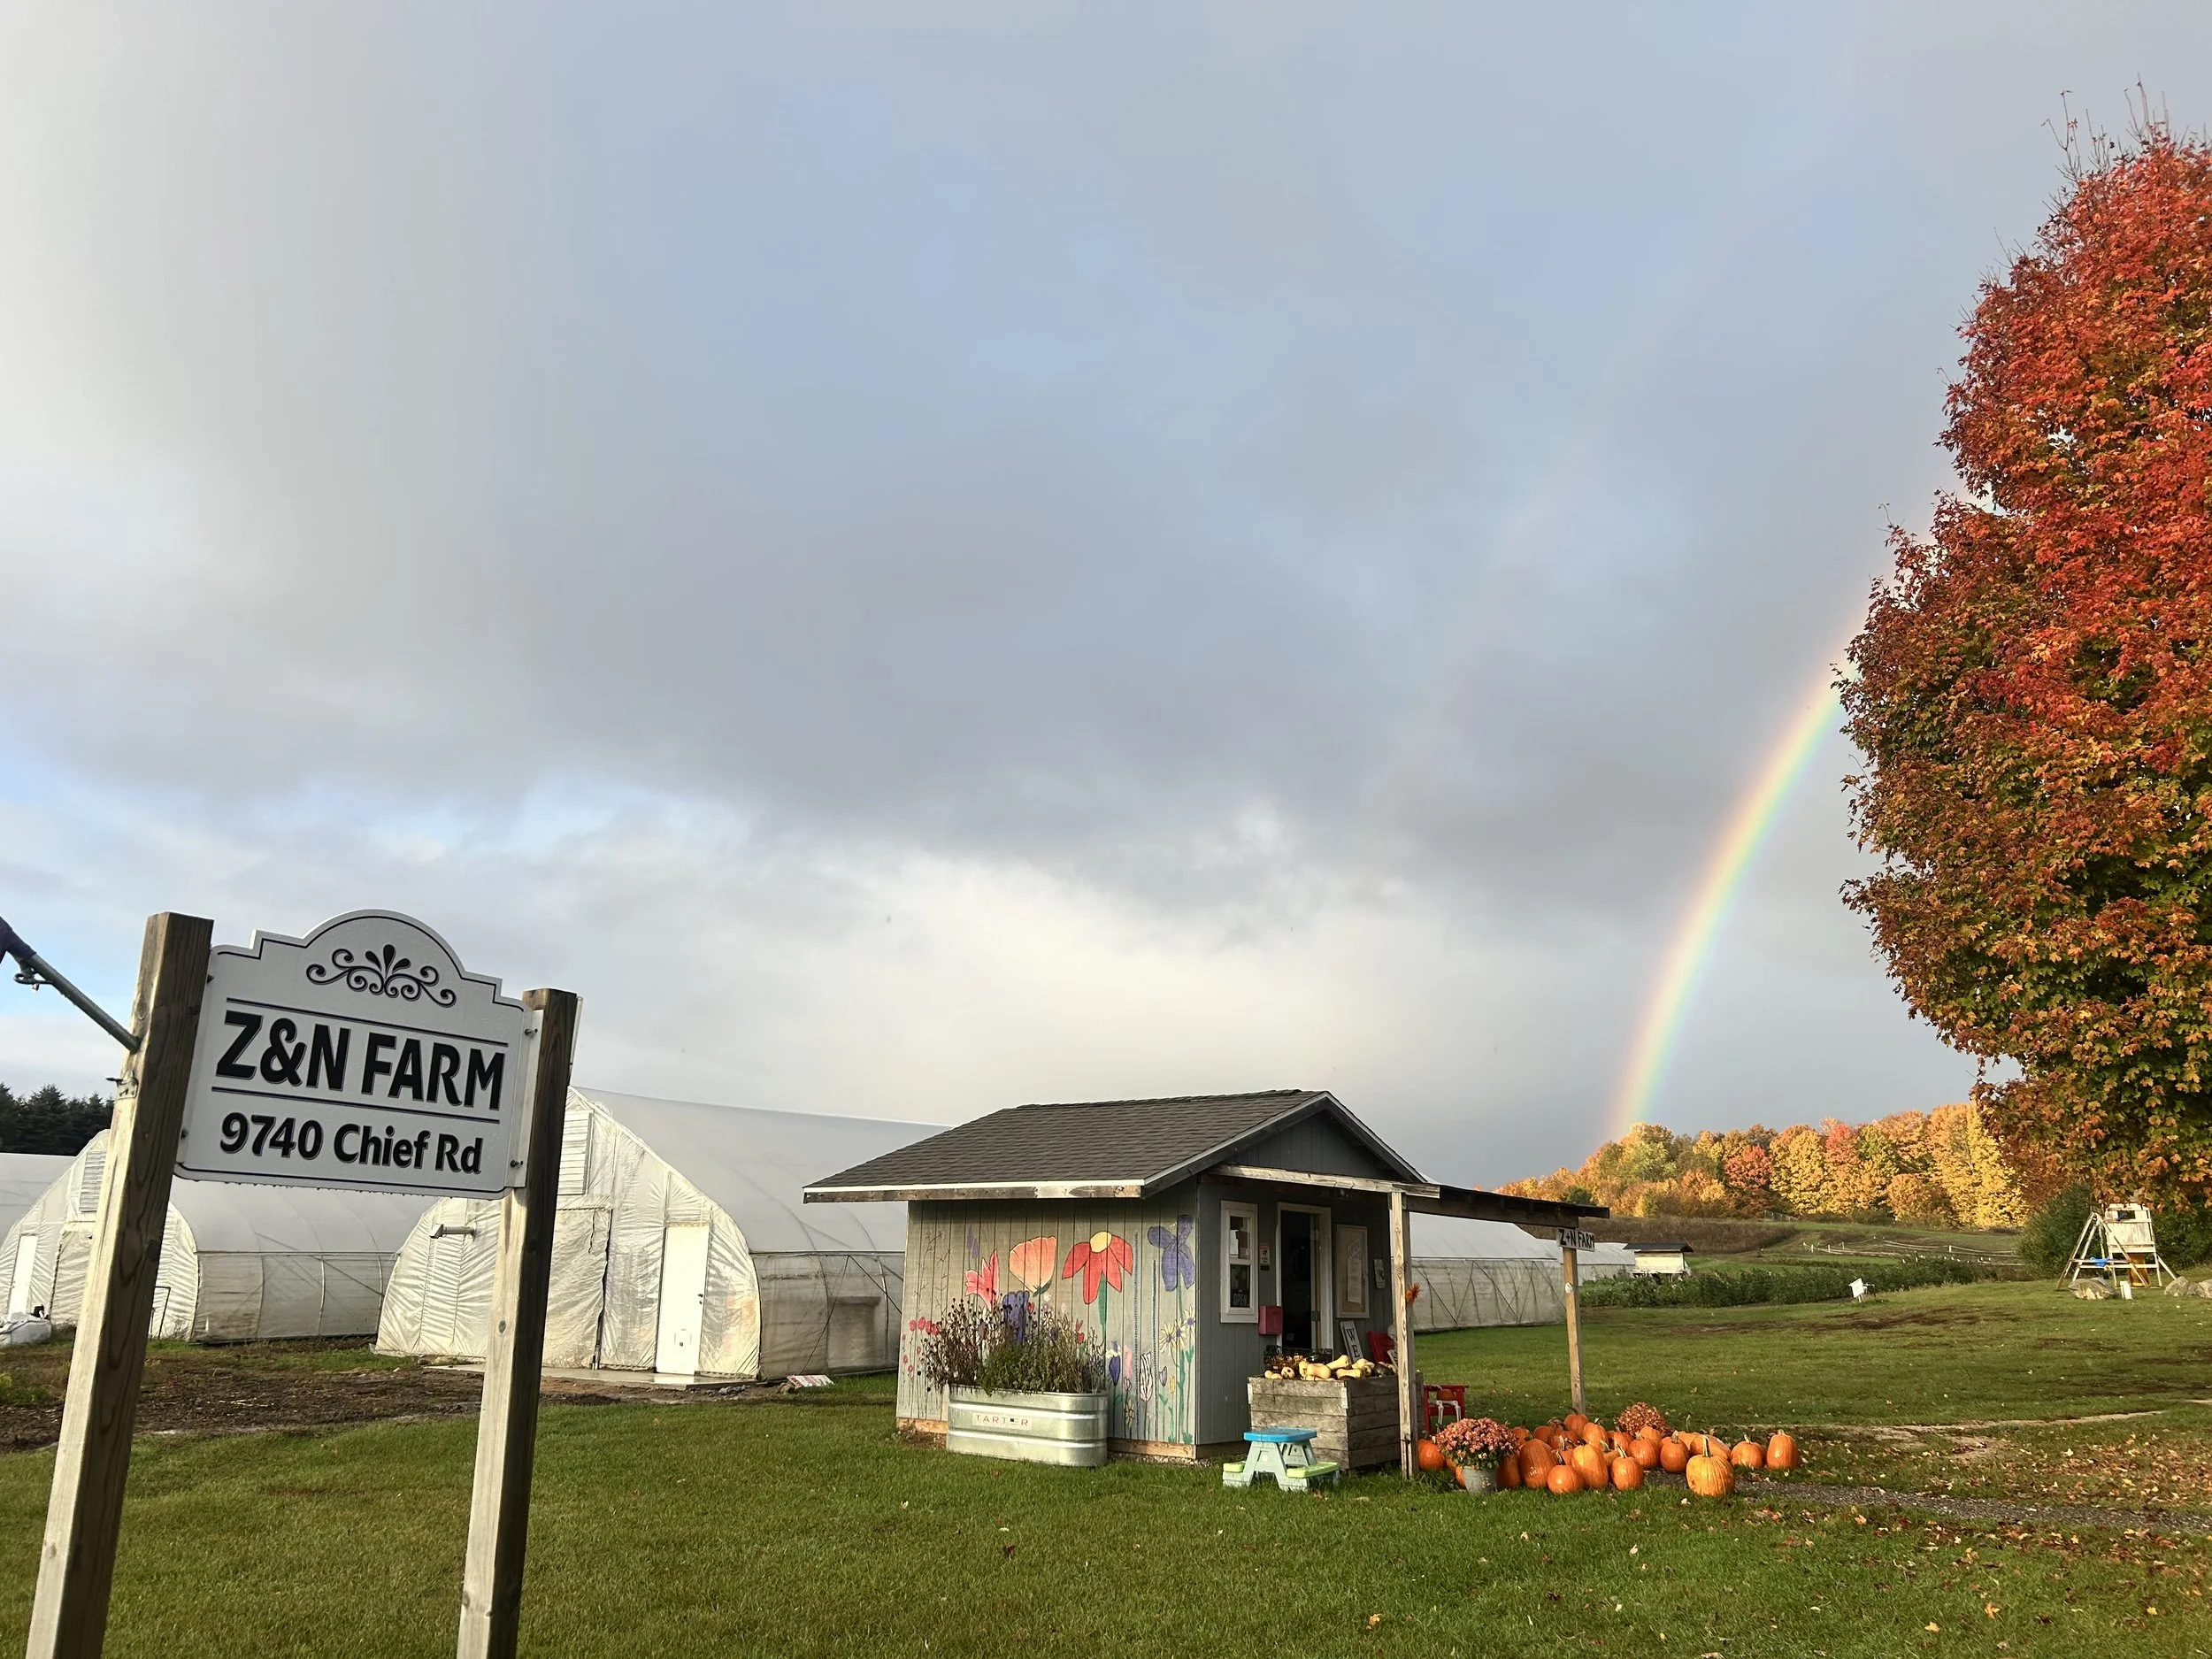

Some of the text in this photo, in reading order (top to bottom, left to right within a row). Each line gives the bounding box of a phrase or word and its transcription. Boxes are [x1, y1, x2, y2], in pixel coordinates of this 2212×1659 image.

[215, 1010, 506, 1111] Z&N FARM
[219, 1111, 484, 1175] 9740 Chief Rd
[1558, 1228, 1595, 1248] Z+N FARM
[975, 1414, 1028, 1426] TARTER
